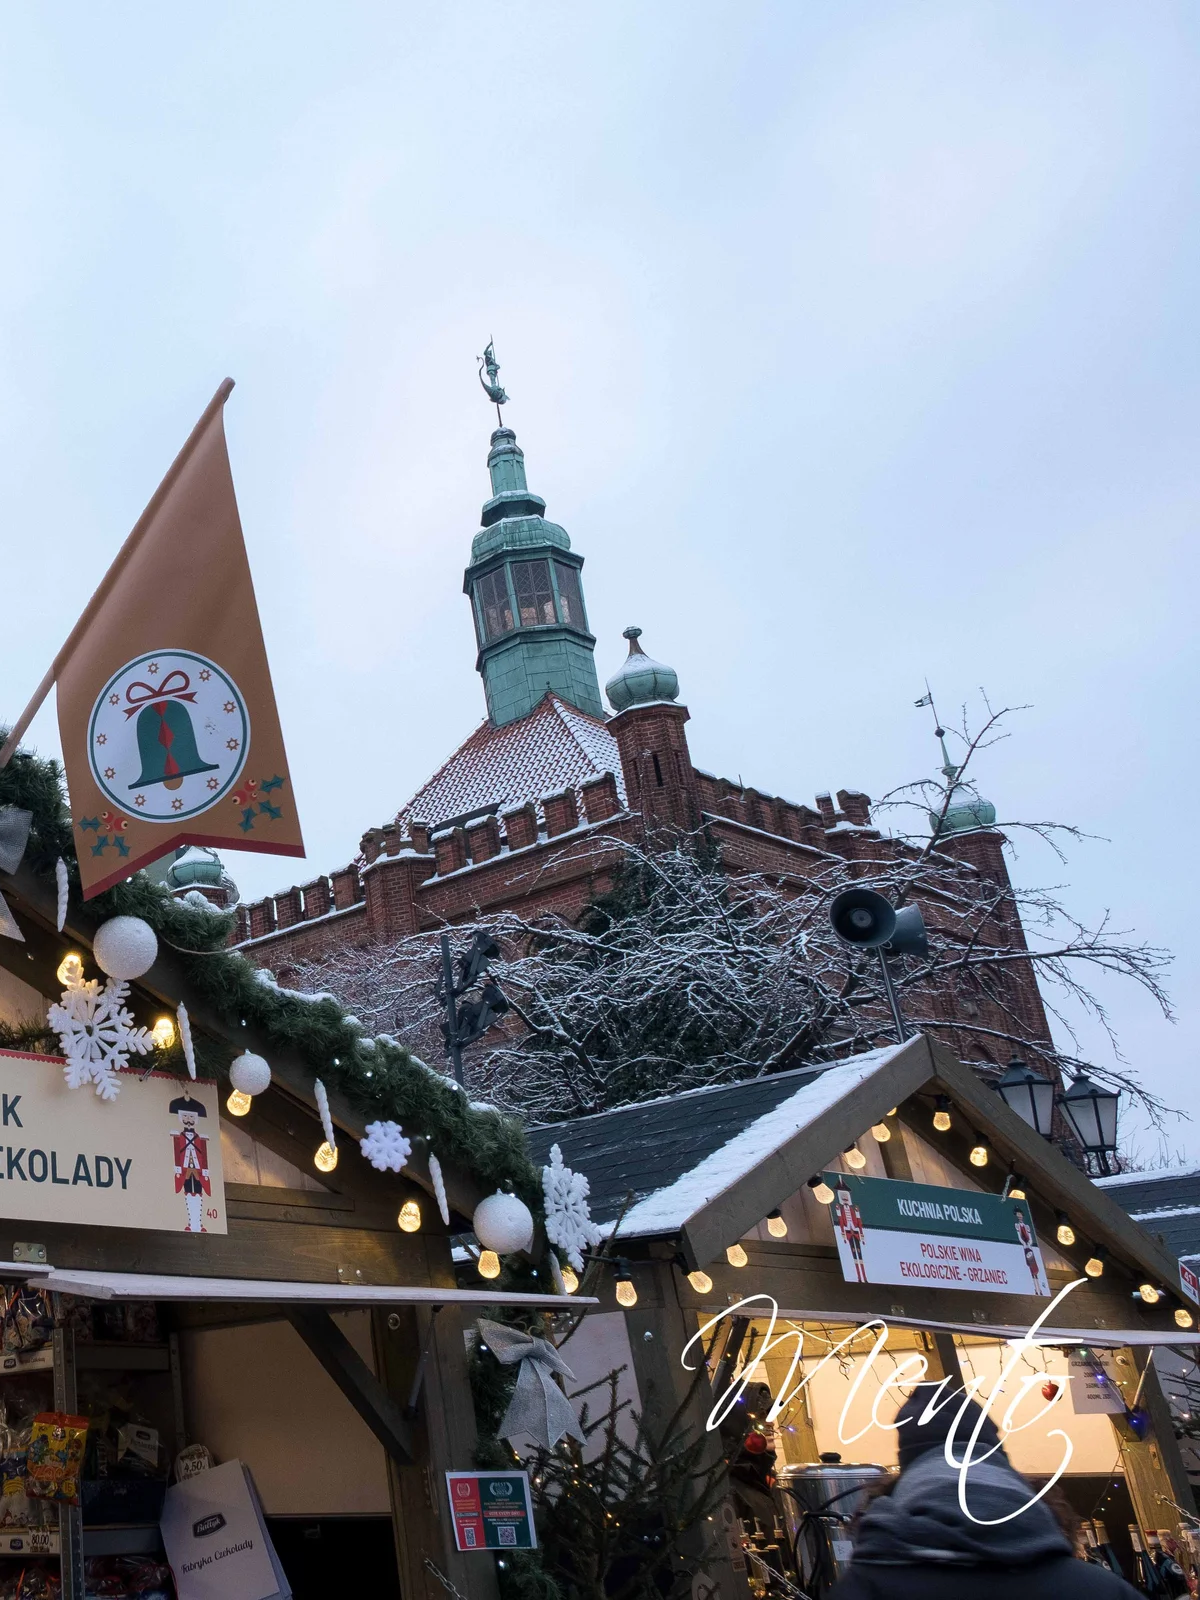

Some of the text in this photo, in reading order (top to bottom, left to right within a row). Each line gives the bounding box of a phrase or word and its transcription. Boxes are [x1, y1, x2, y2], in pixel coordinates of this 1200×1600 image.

[206, 1208, 218, 1220] 40
[897, 1198, 983, 1225] KUCHNIA POLSKA
[920, 1243, 983, 1263] POLSKIE WINA
[900, 1262, 962, 1281] EKOLOGICZNE
[968, 1268, 1008, 1285] GRZANIEC
[1184, 1271, 1193, 1285] 41
[184, 1460, 203, 1473] 4,50
[181, 1540, 254, 1574] Fabryka Czekolady
